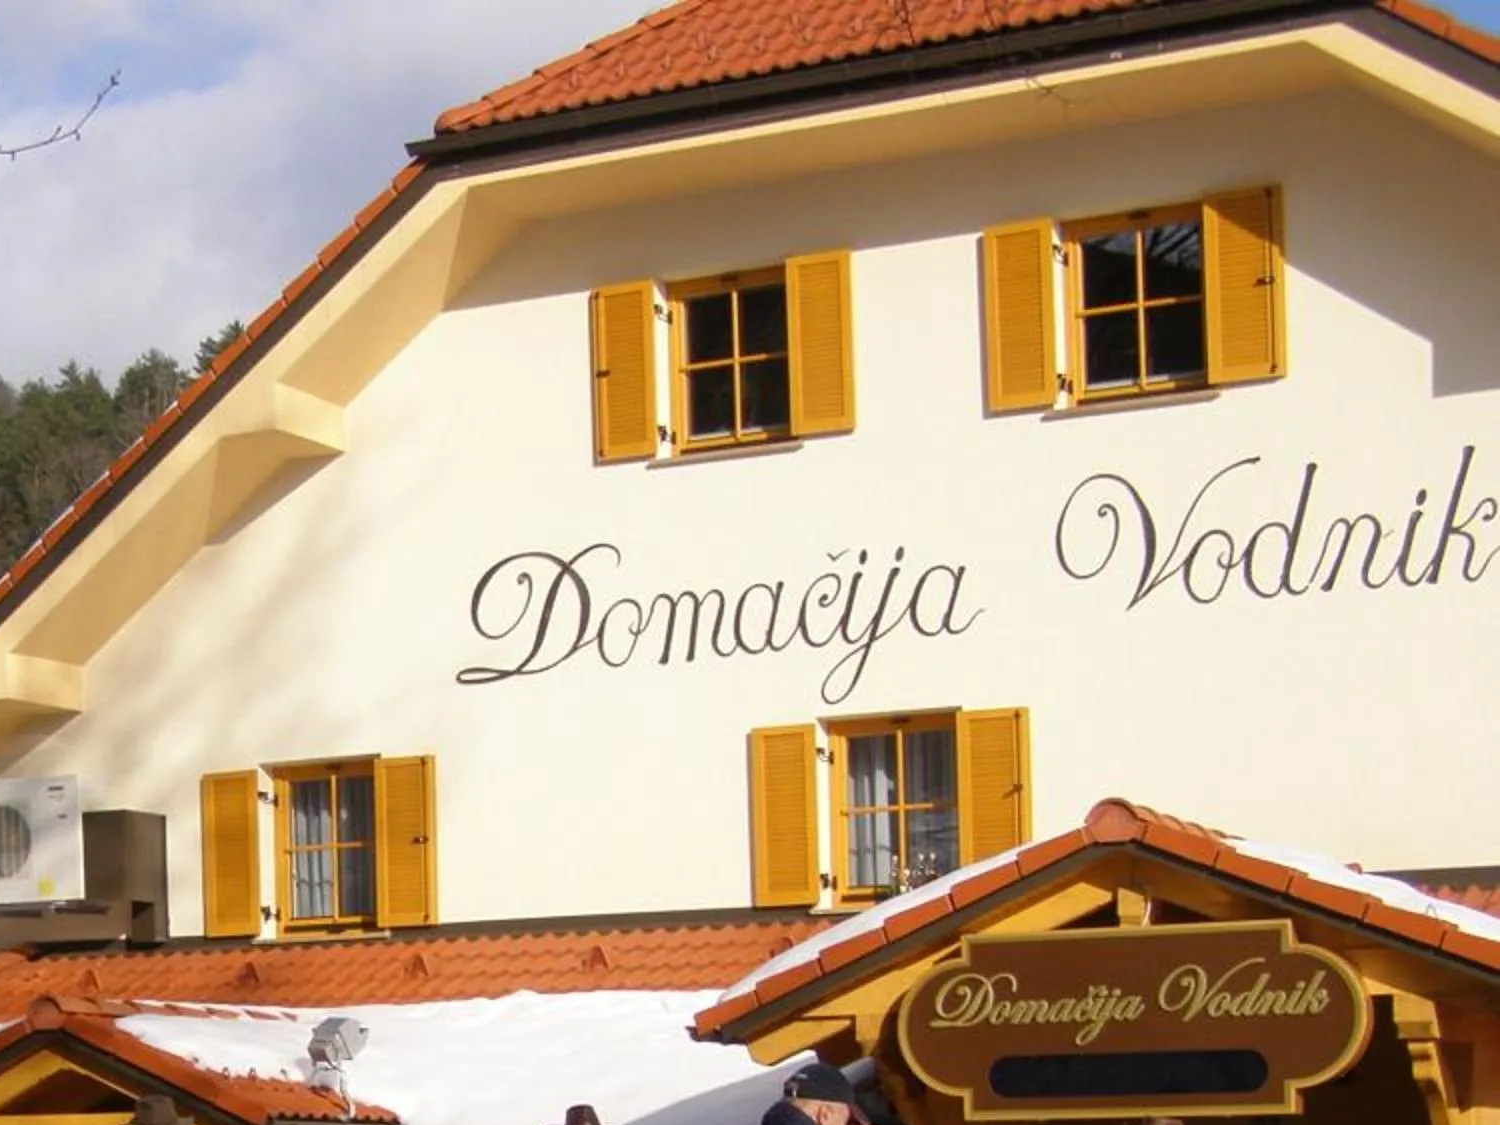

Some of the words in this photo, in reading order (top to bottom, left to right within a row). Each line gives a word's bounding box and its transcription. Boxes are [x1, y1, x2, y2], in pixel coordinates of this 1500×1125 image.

[456, 543, 986, 705] Domačija
[1055, 444, 1500, 612] Vodnik
[930, 972, 1145, 1046] Domačija
[1157, 956, 1332, 1022] Vodnik
